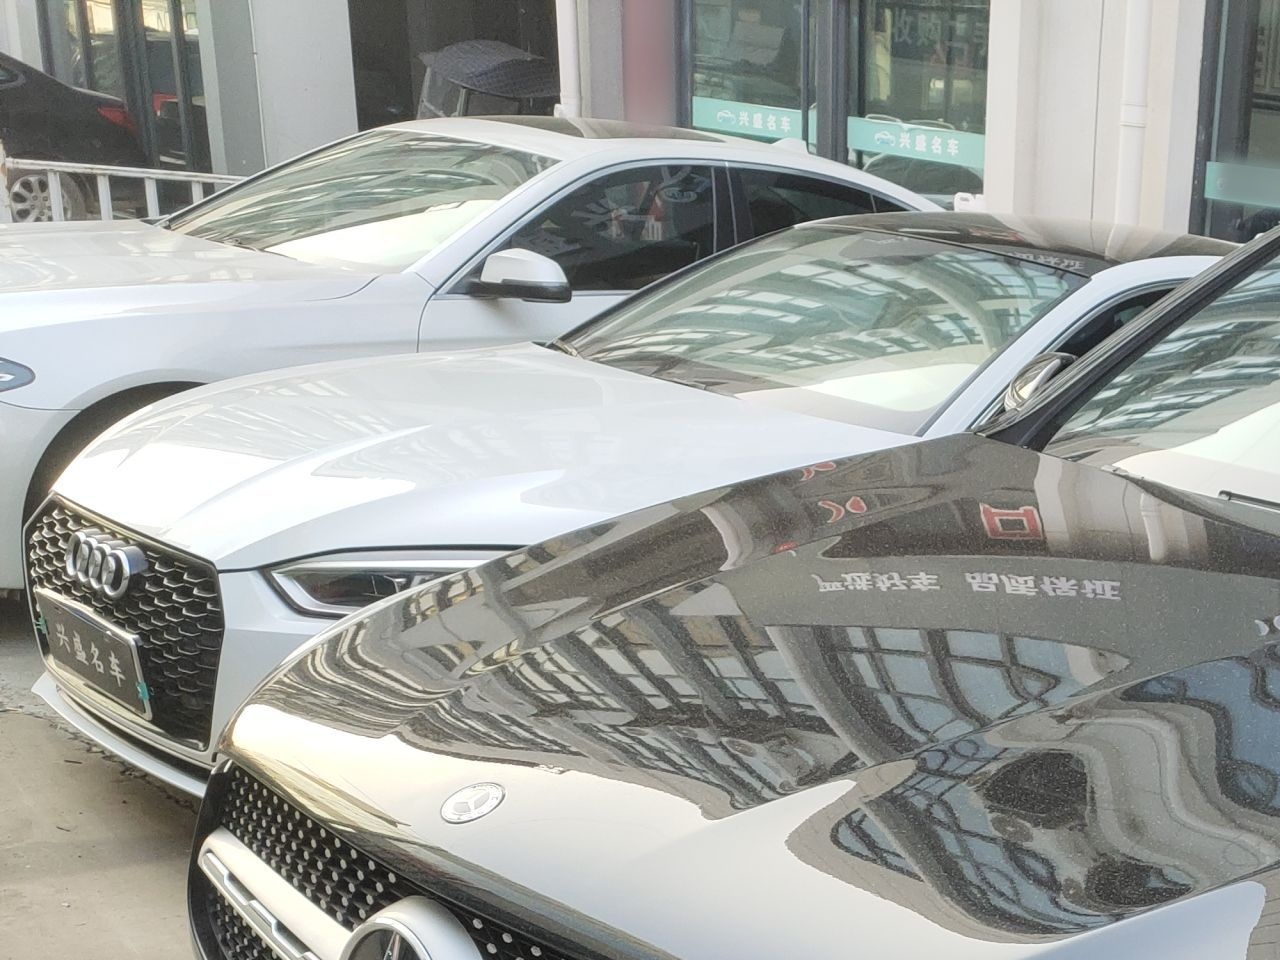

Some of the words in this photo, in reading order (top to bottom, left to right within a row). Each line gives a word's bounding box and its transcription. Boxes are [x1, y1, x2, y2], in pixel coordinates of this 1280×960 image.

[738, 111, 792, 133] 兴盛名车
[899, 131, 959, 155] 兴盛名车
[56, 623, 126, 687] 兴盛名车
